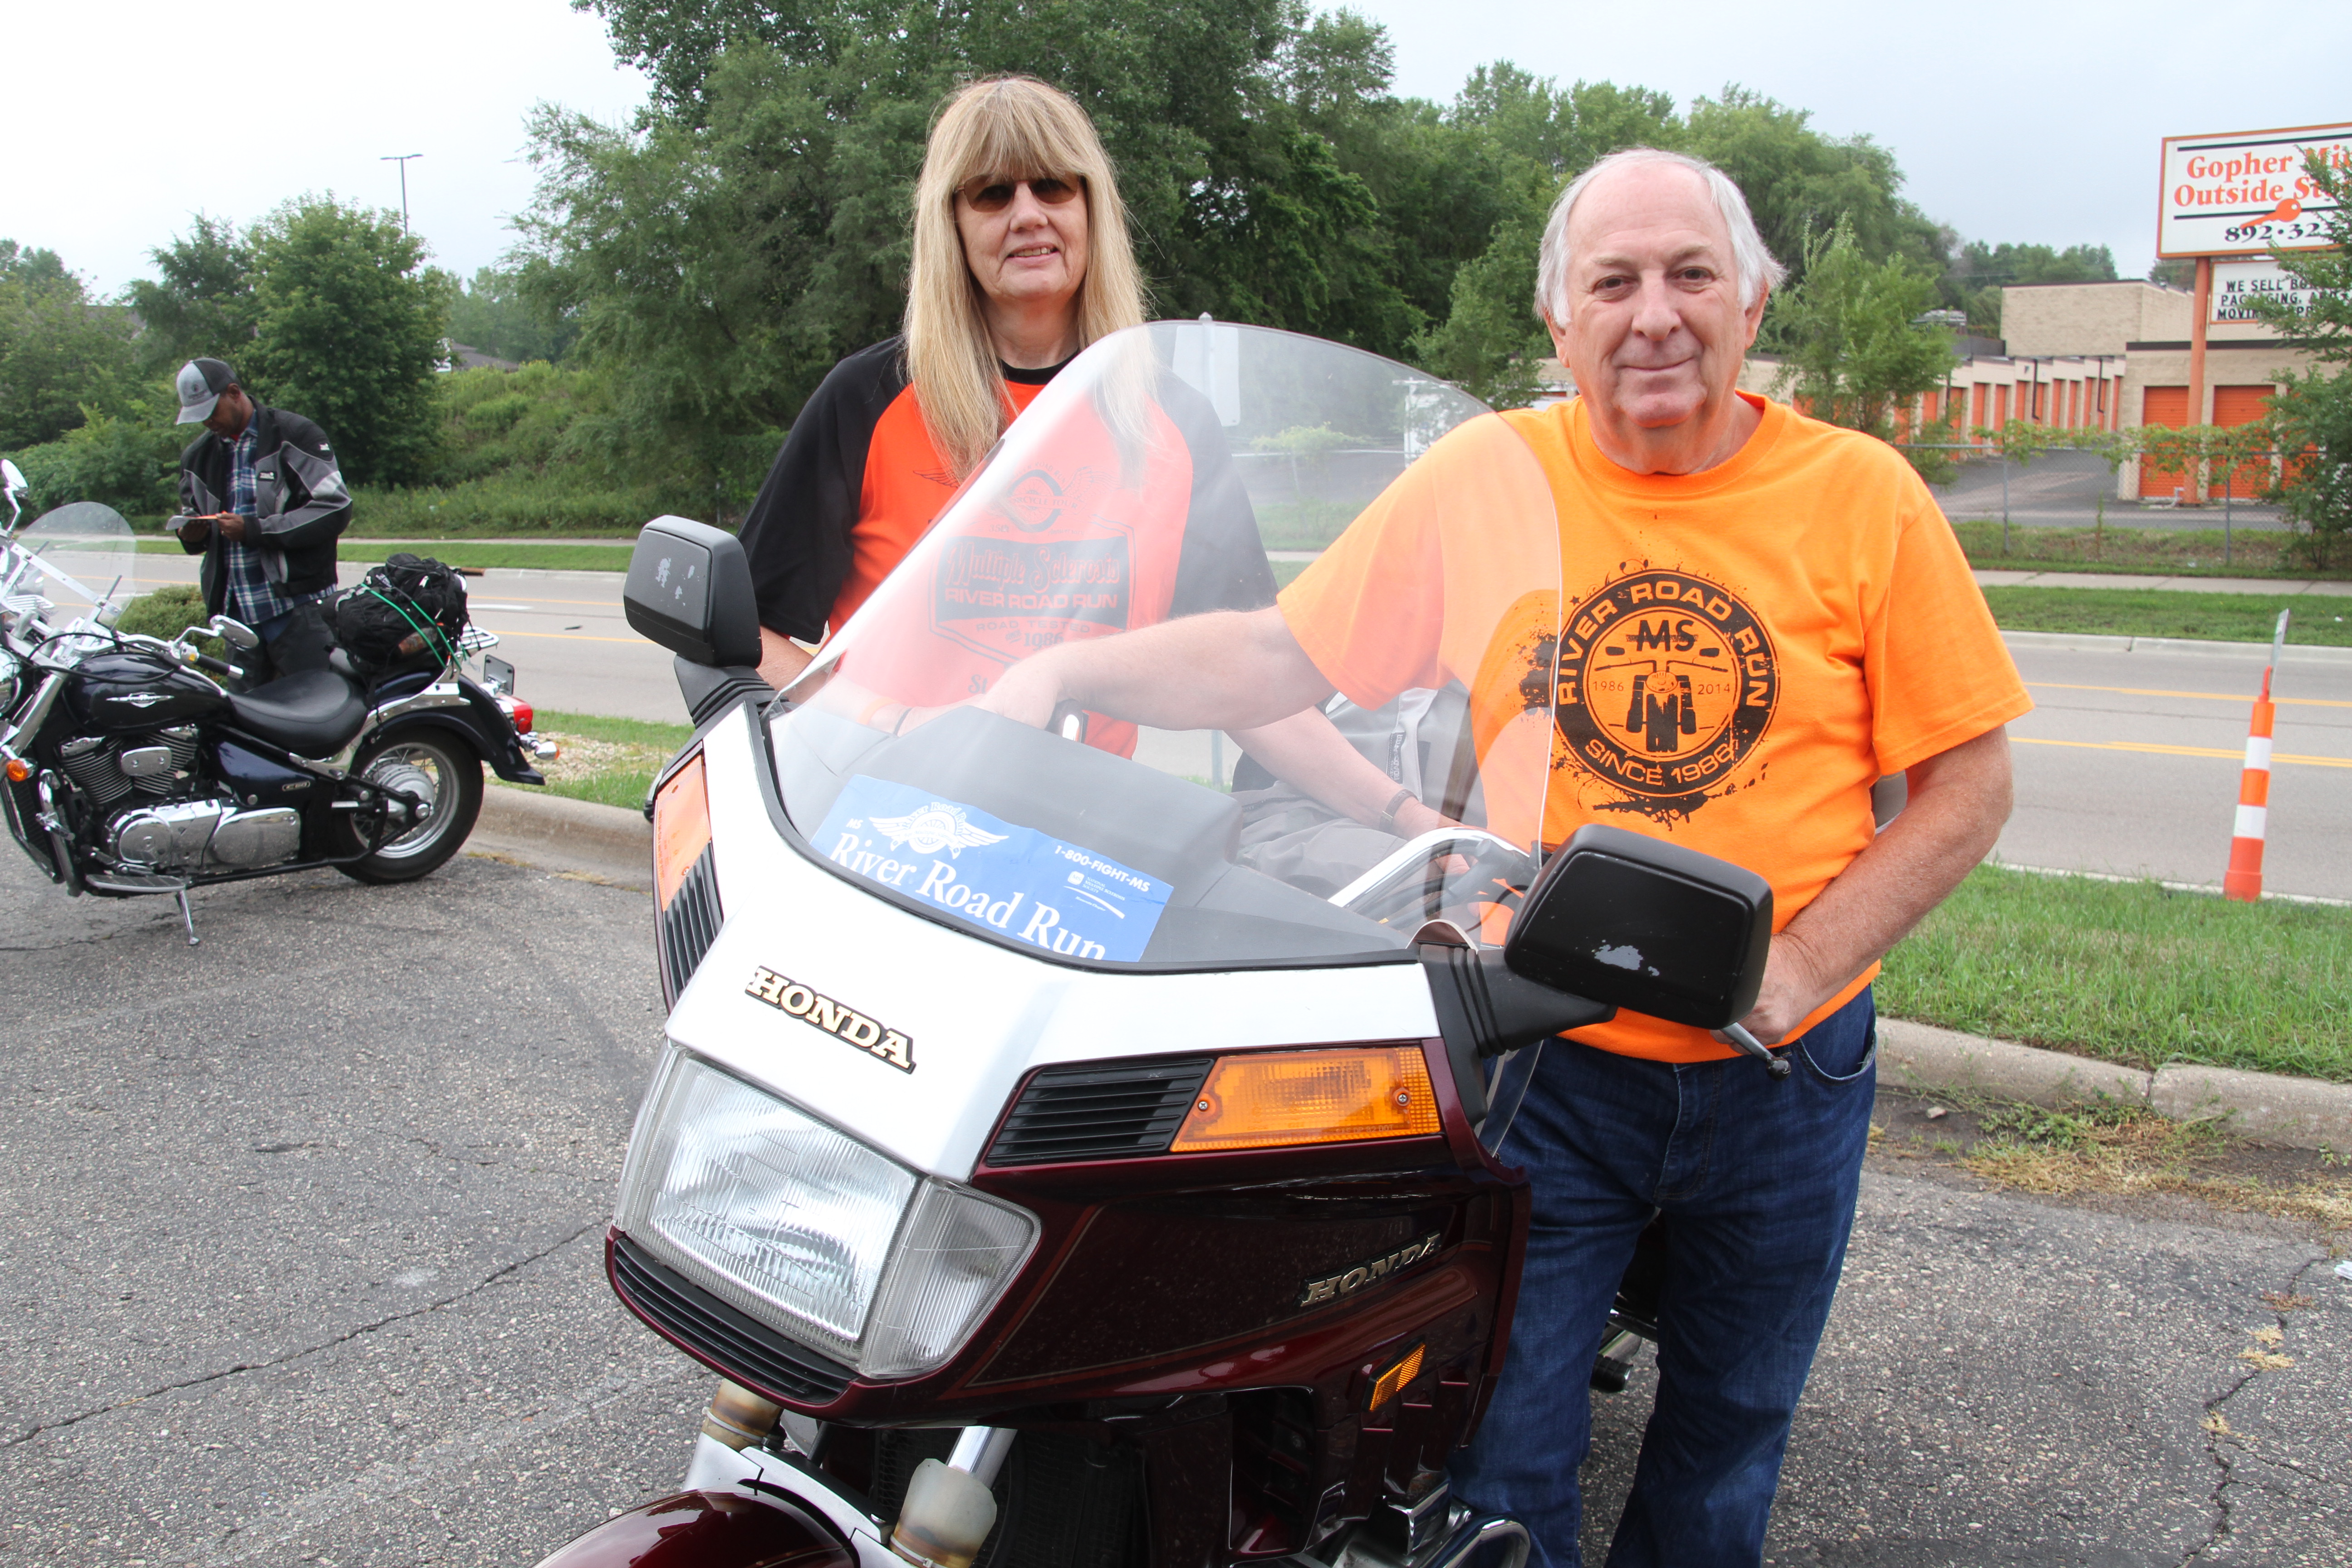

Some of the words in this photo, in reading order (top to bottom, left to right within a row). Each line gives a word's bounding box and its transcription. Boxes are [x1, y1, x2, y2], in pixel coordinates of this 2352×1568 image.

[2187, 152, 2293, 182] Gopher
[2174, 179, 2283, 207] Outside
[2226, 280, 2244, 293] WE
[2251, 279, 2283, 291] SELL
[1053, 499, 1078, 509] TOUR
[943, 541, 1026, 591] Multiple
[1028, 546, 1121, 594] Sclerosis
[945, 588, 1004, 608] RIVER
[1009, 593, 1069, 610] ROAD
[1072, 594, 1117, 609] RUN
[975, 620, 1019, 632] ROAD
[1026, 620, 1091, 633] TESTED
[1635, 619, 1696, 652] MS
[1558, 598, 1619, 706] RIVER
[1630, 581, 1732, 622] ROAD
[1734, 626, 1769, 707] RUN
[1593, 681, 1624, 691] 1986
[1697, 683, 1731, 696] 2014
[1585, 738, 1663, 786] SINCE
[1671, 743, 1736, 784] 1986
[846, 818, 862, 830] MS
[902, 805, 929, 829] River
[930, 802, 962, 816] Road
[954, 811, 967, 835] Run
[1055, 845, 1151, 893] 1-800-FIGHT-MS
[829, 833, 917, 887] River
[915, 860, 1024, 930] Road
[1017, 901, 1106, 961] Run
[745, 966, 913, 1072] HONDA
[1299, 1232, 1441, 1308] HONDA
